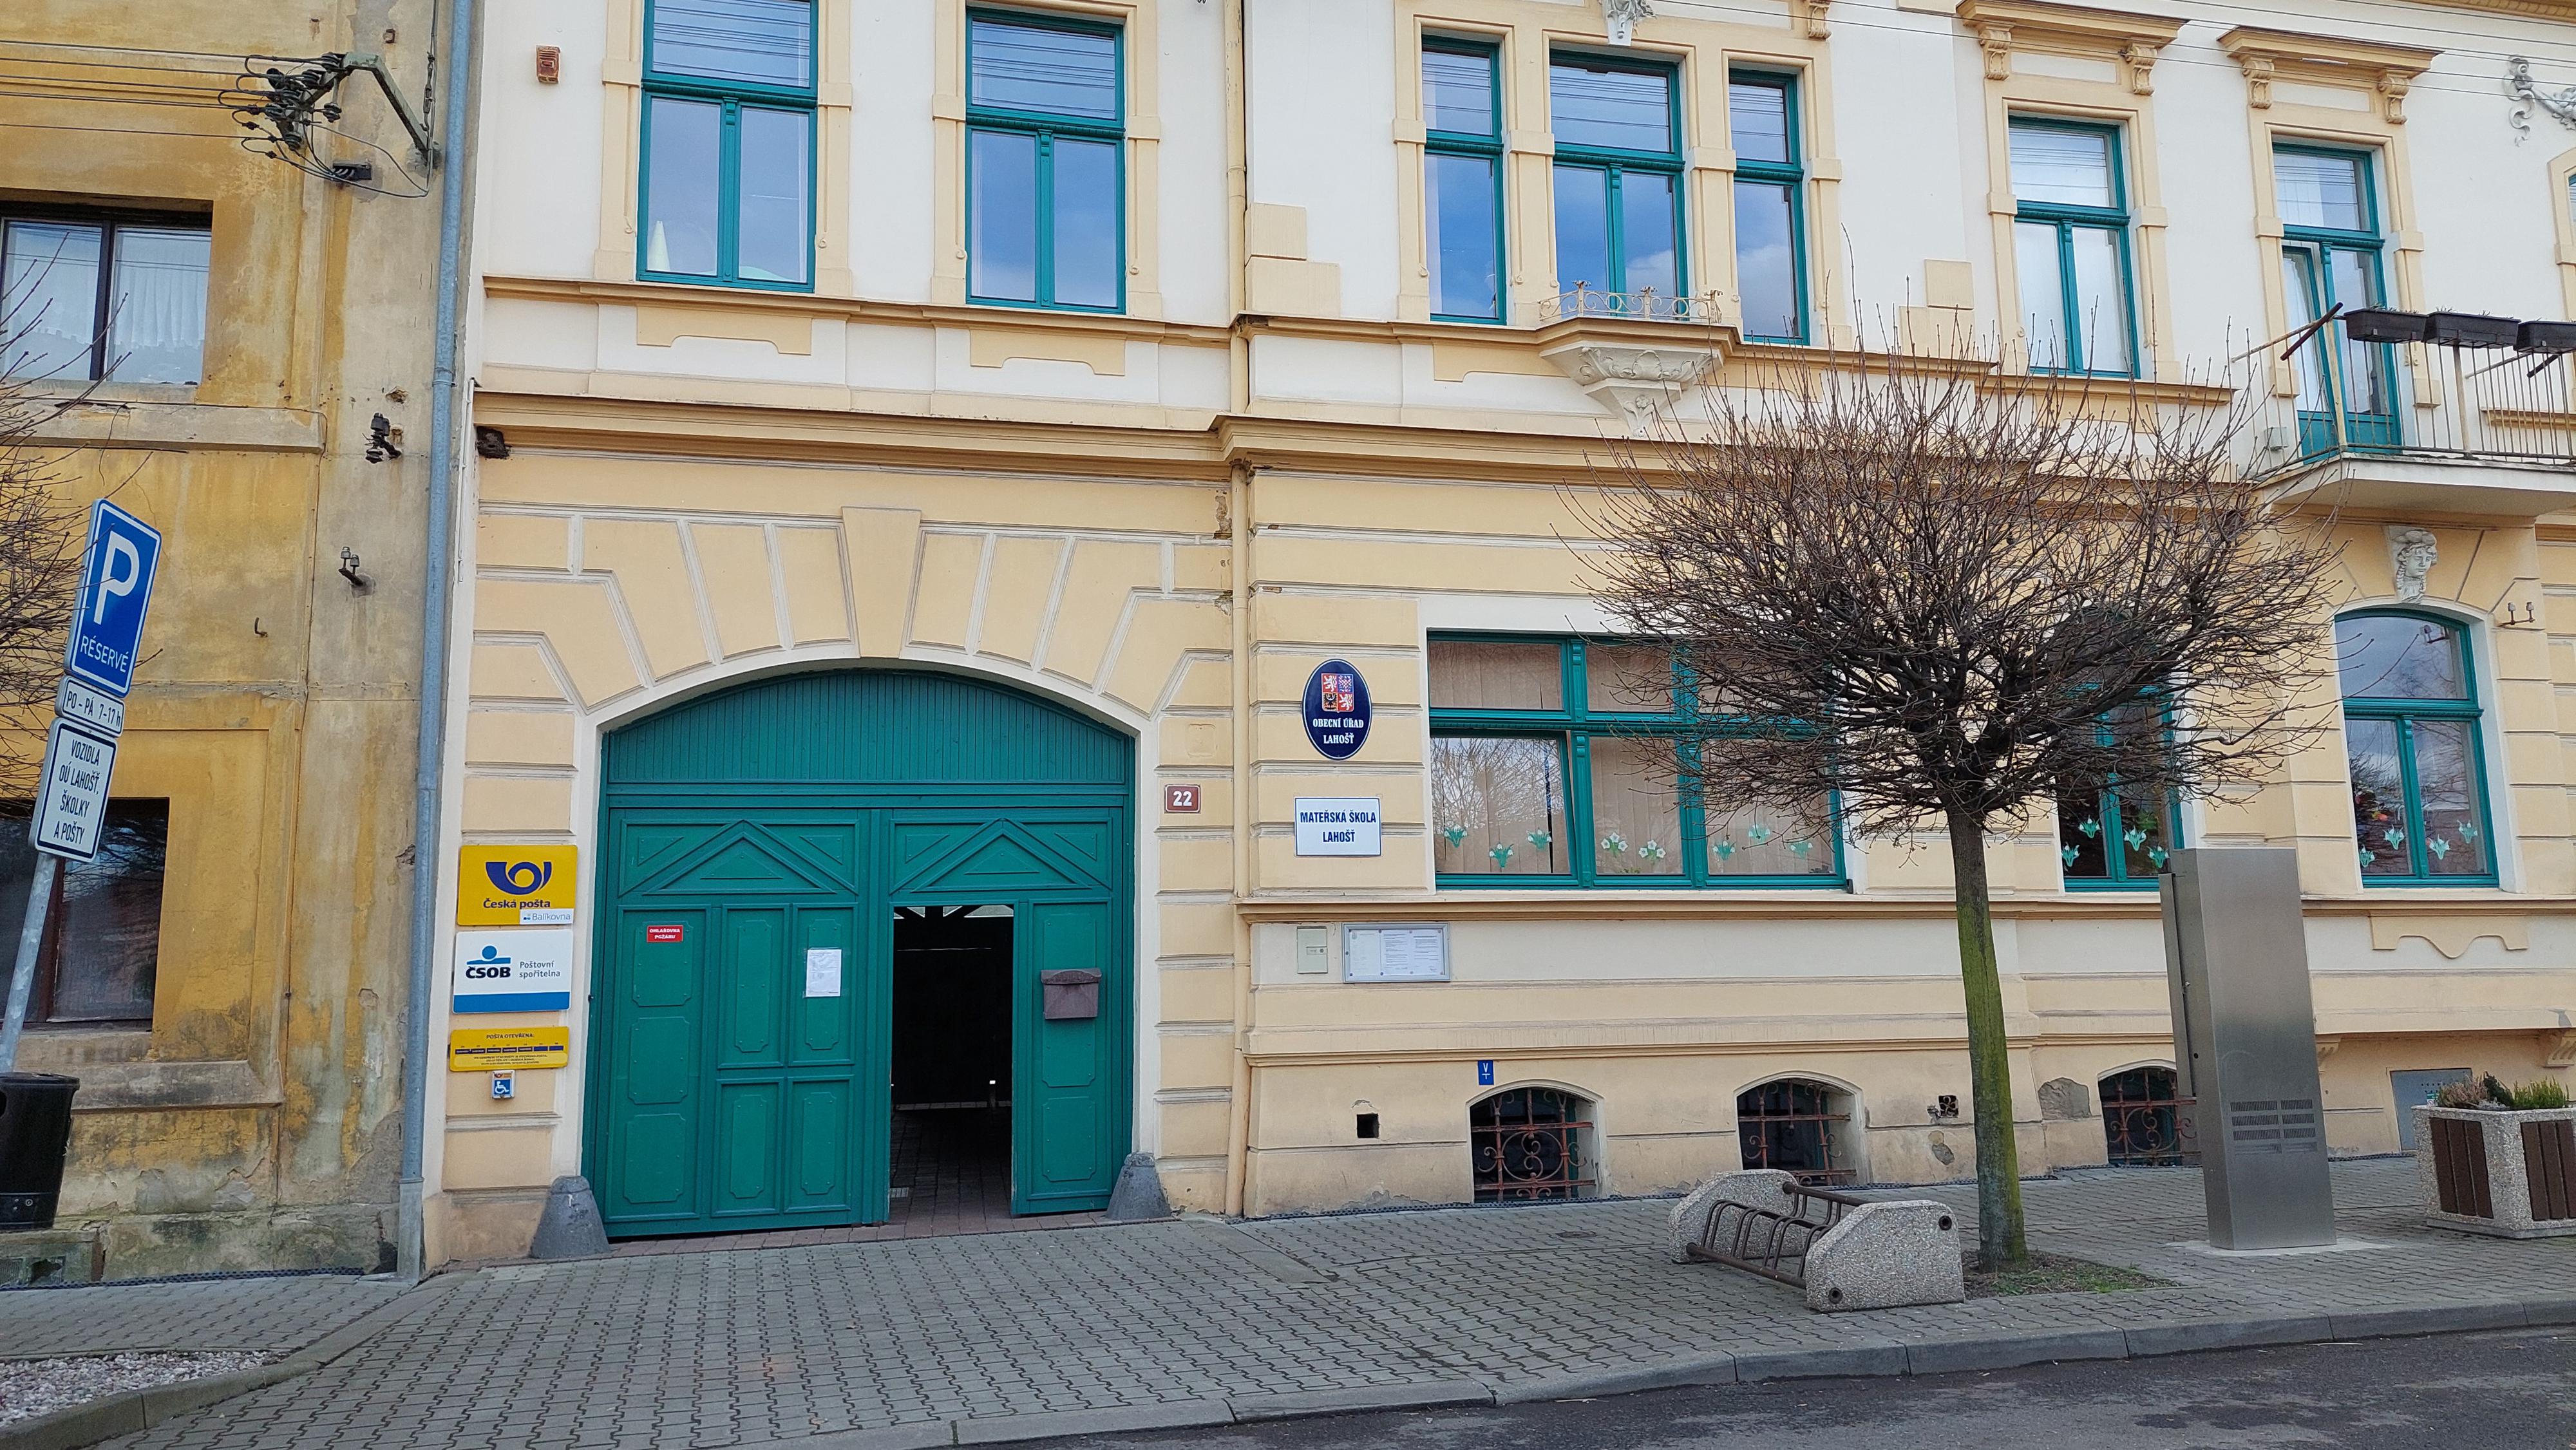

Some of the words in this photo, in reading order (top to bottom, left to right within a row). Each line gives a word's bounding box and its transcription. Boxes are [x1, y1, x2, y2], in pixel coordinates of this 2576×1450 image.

[93, 530, 140, 625] P
[80, 635, 129, 673] RÉSERVÉ
[66, 690, 77, 710] PO
[84, 696, 95, 717] PÁ
[99, 703, 116, 724] 7-17
[116, 710, 121, 728] h
[1312, 717, 1341, 728] OBECNÍ
[1343, 717, 1364, 728] ÚŘAD
[1323, 733, 1354, 744] LAHOŠŤ
[71, 739, 100, 766] VOZIDLA
[59, 761, 71, 784] OÚ
[70, 768, 100, 795] LAHOŠŤ,
[60, 789, 90, 818] ŠKOLKY
[1173, 791, 1192, 806] 22
[1300, 809, 1347, 823] MATEŘSKÁ
[1349, 809, 1376, 823] ŠKOLA
[53, 820, 62, 839] A
[61, 820, 85, 845] POŠTY
[1322, 829, 1355, 843] LAHOŠŤ
[483, 898, 516, 909] Česká
[519, 899, 551, 910] pošta
[520, 961, 554, 969] Poštovní
[466, 966, 511, 979] ČSOB
[519, 970, 561, 979] spořitelna
